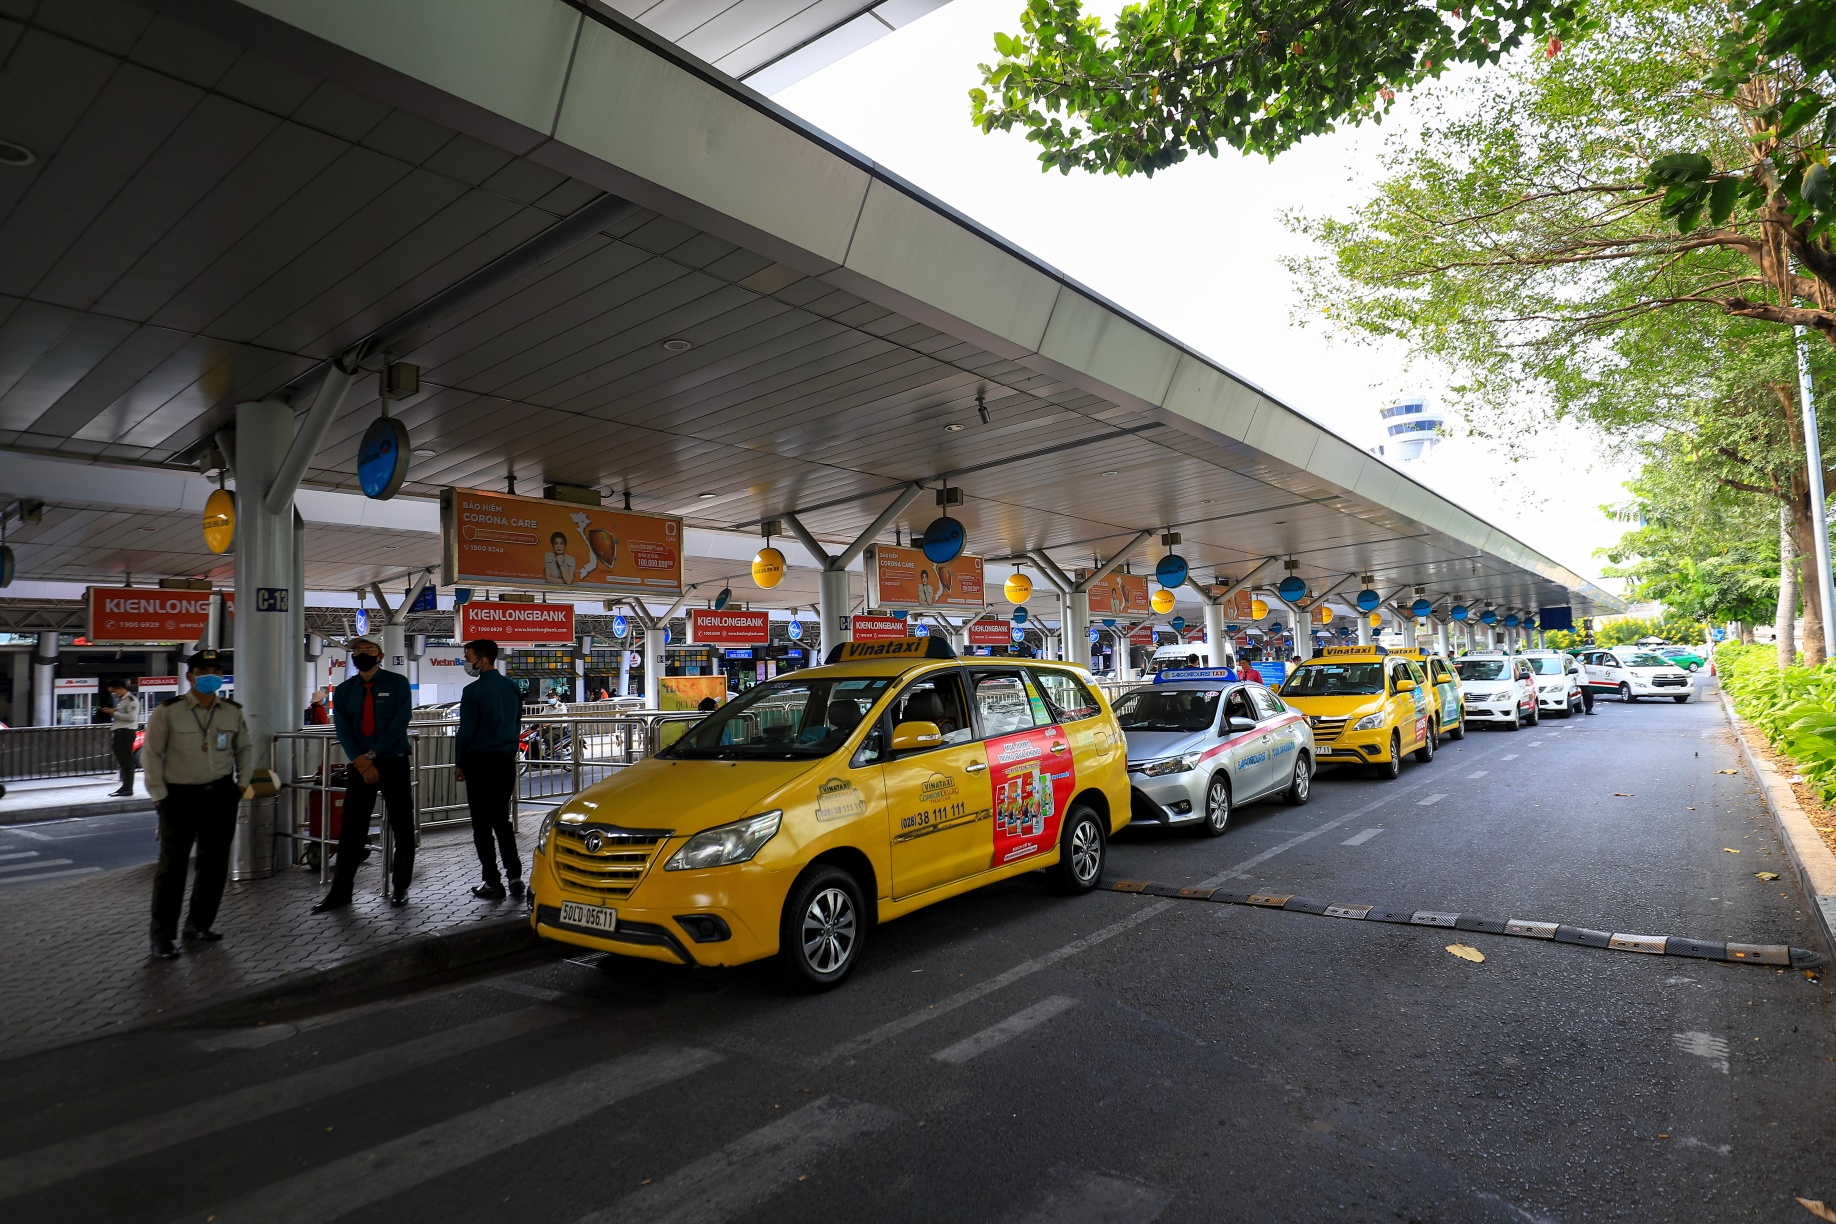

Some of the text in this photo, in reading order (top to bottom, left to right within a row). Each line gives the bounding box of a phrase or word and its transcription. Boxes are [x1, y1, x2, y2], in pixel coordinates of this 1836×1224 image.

[463, 513, 538, 529] CORONA CARE
[470, 544, 487, 552] 1900
[105, 599, 234, 614] KIENLONGA
[258, 590, 288, 611] C-13
[469, 608, 566, 622] KIENLONGBANK
[697, 616, 763, 627] KIENLONGBANK
[855, 621, 904, 631] KIENLONGBANK
[849, 638, 923, 658] Vinataxi
[1326, 647, 1372, 656] Vinataxi
[821, 783, 851, 793] VINATAXI
[924, 779, 953, 791] VINATAXI
[900, 802, 965, 830] (028) 38 111 111
